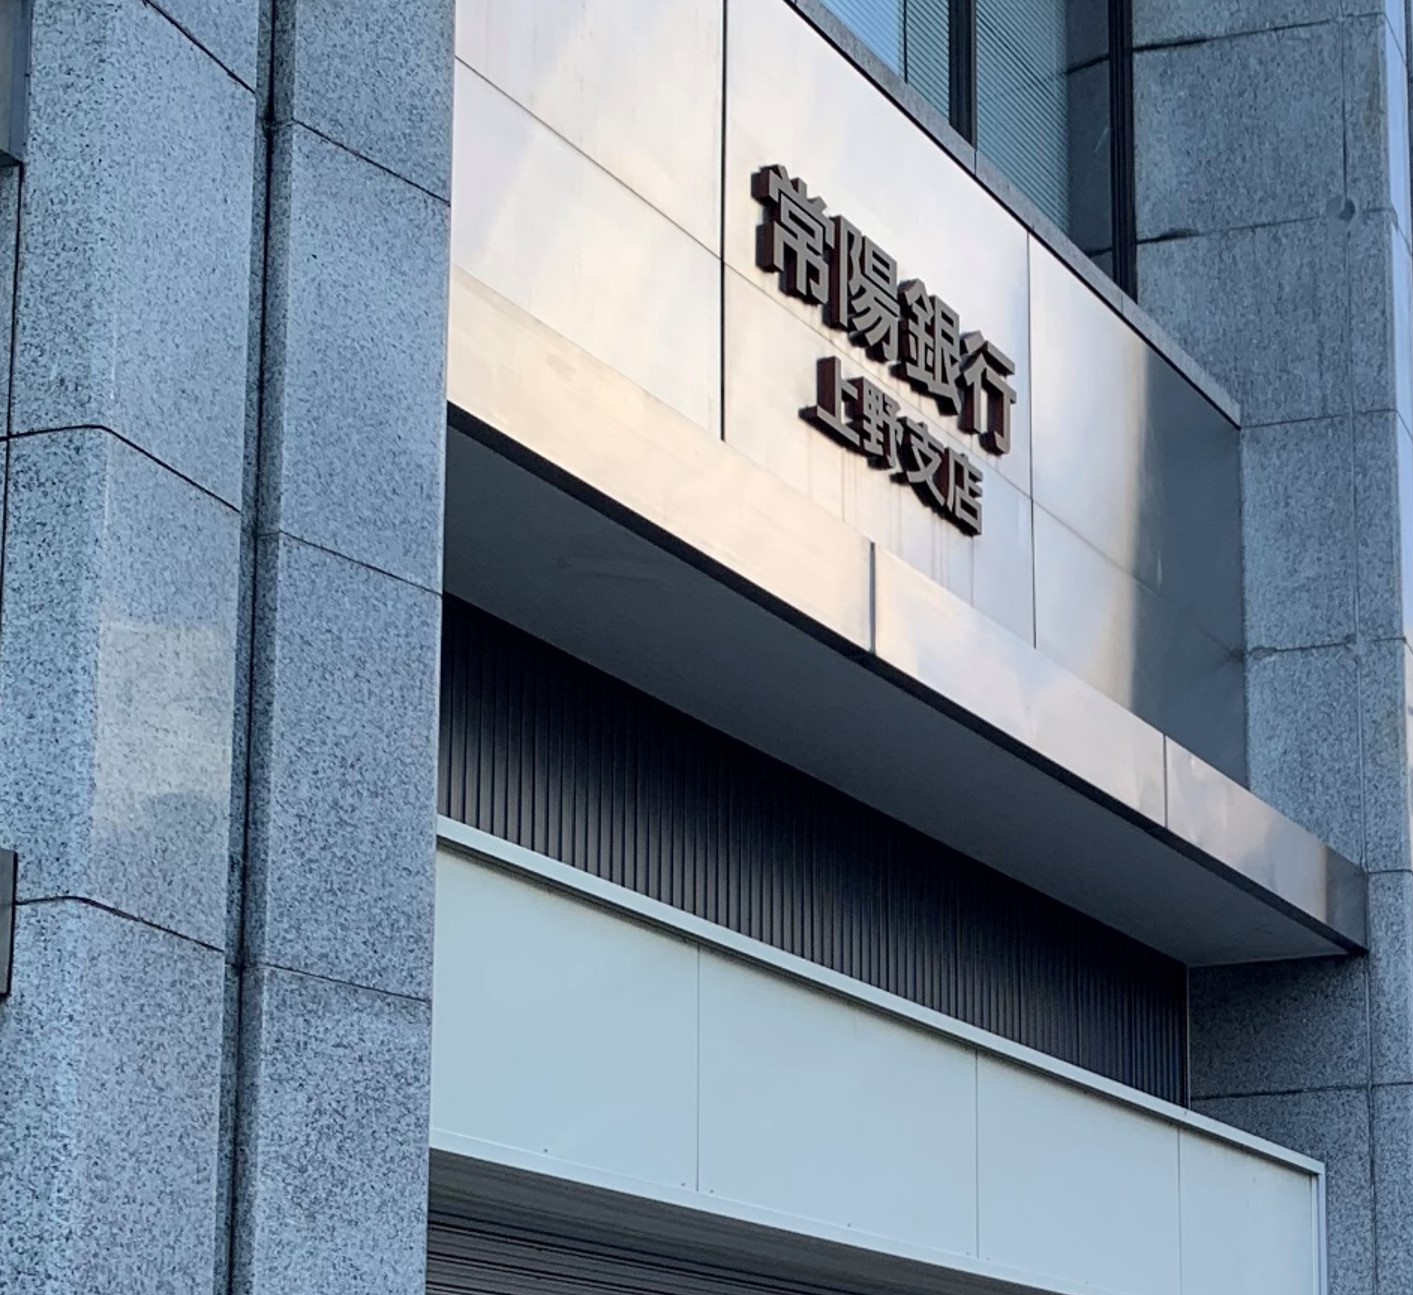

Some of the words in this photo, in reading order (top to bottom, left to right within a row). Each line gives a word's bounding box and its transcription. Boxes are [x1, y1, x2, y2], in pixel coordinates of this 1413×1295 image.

[751, 164, 1016, 455] 常陽銀行
[799, 356, 983, 537] 上野支店
